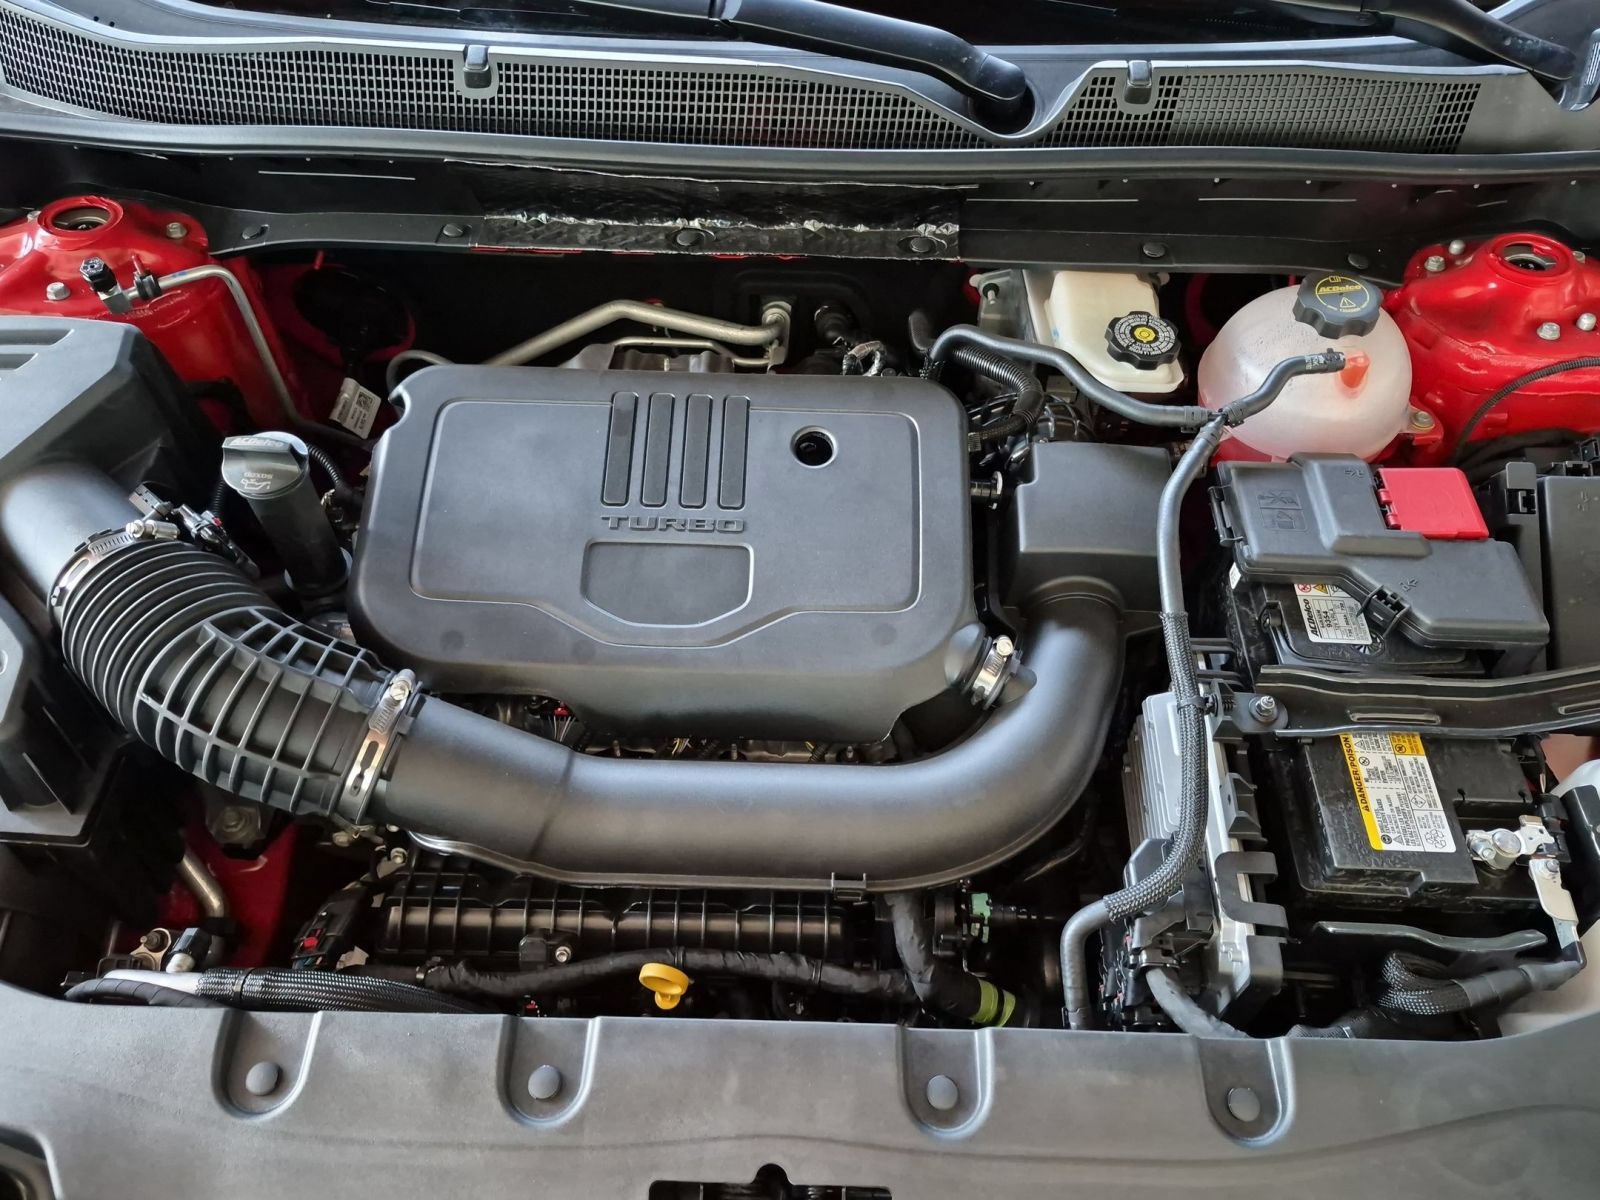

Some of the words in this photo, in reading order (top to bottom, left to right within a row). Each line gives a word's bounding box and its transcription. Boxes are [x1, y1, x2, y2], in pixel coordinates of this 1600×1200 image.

[1318, 284, 1361, 293] ACDelco
[230, 438, 282, 448] ACDelco
[244, 472, 273, 480] dexos
[601, 515, 744, 533] TURBO
[1301, 599, 1319, 636] ACDelco
[1322, 611, 1333, 628] 9354
[1341, 737, 1368, 804] DANGER/POISON
